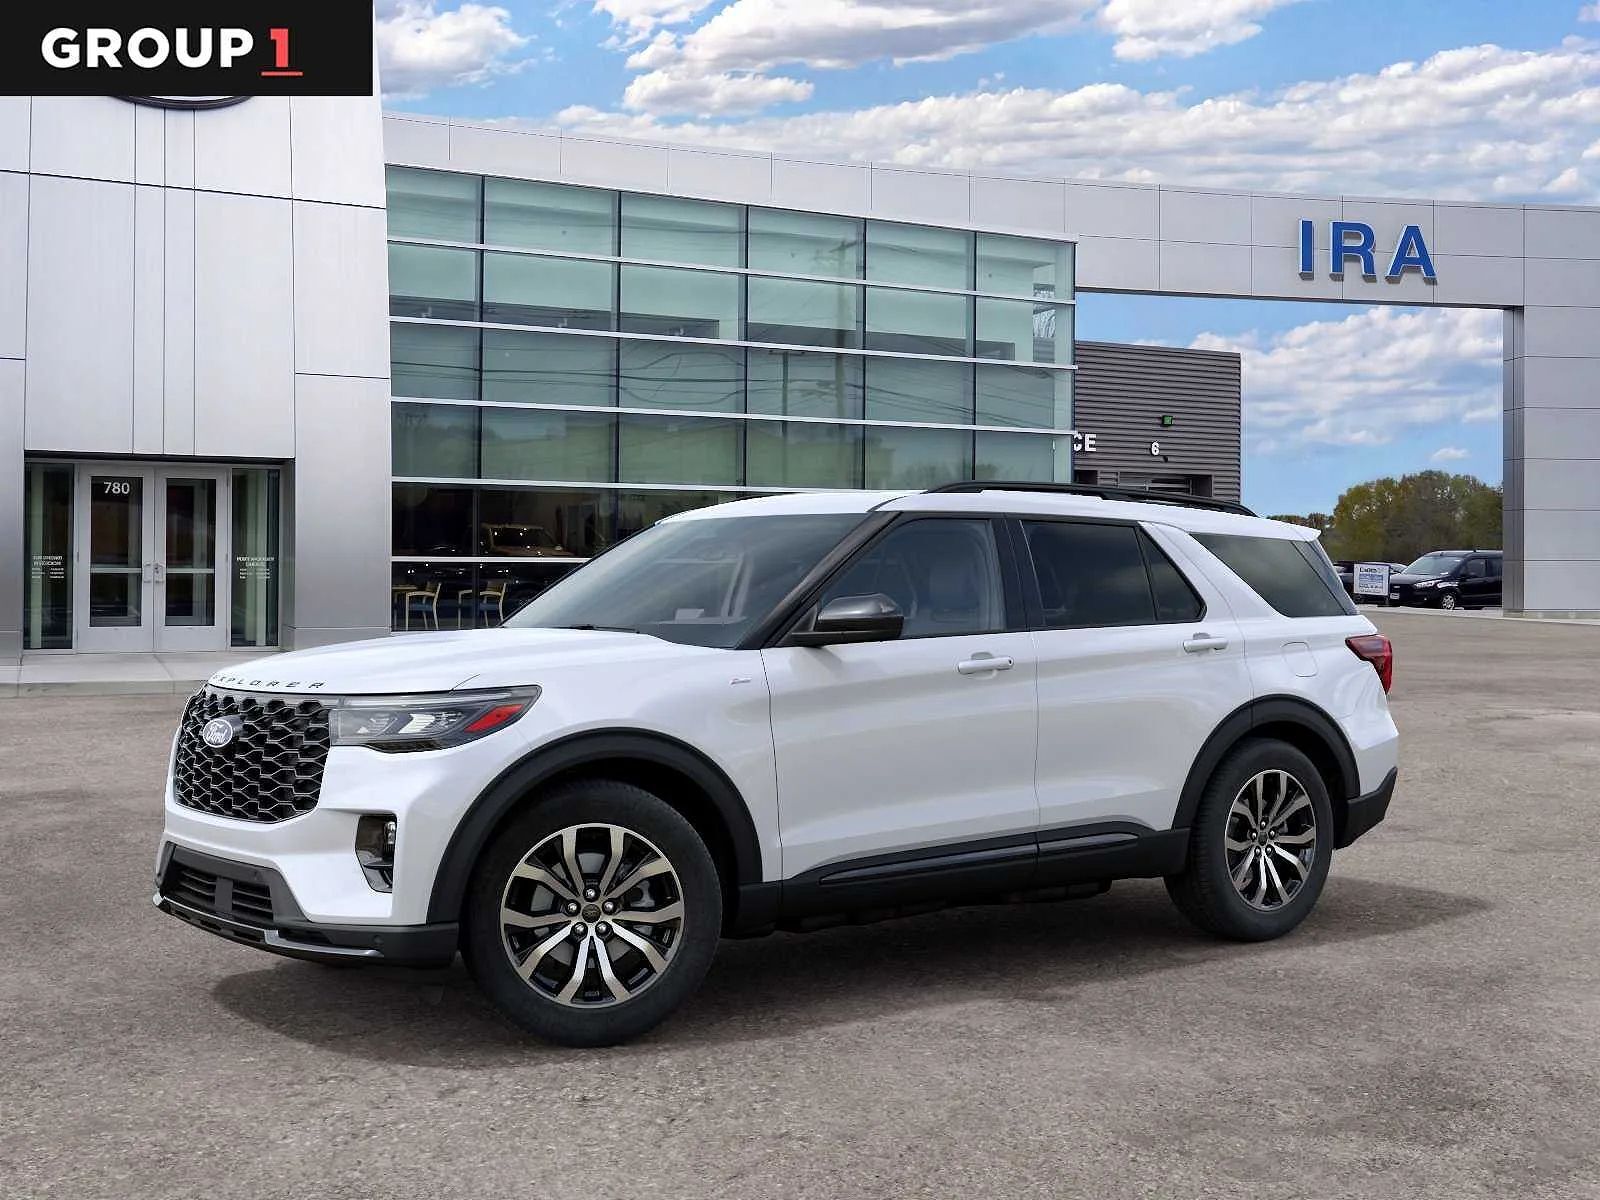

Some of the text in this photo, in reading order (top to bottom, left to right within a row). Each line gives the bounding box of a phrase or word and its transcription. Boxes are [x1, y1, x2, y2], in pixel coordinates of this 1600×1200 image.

[1299, 217, 1437, 284] IRA
[1150, 441, 1160, 455] 6
[103, 481, 130, 495] 780
